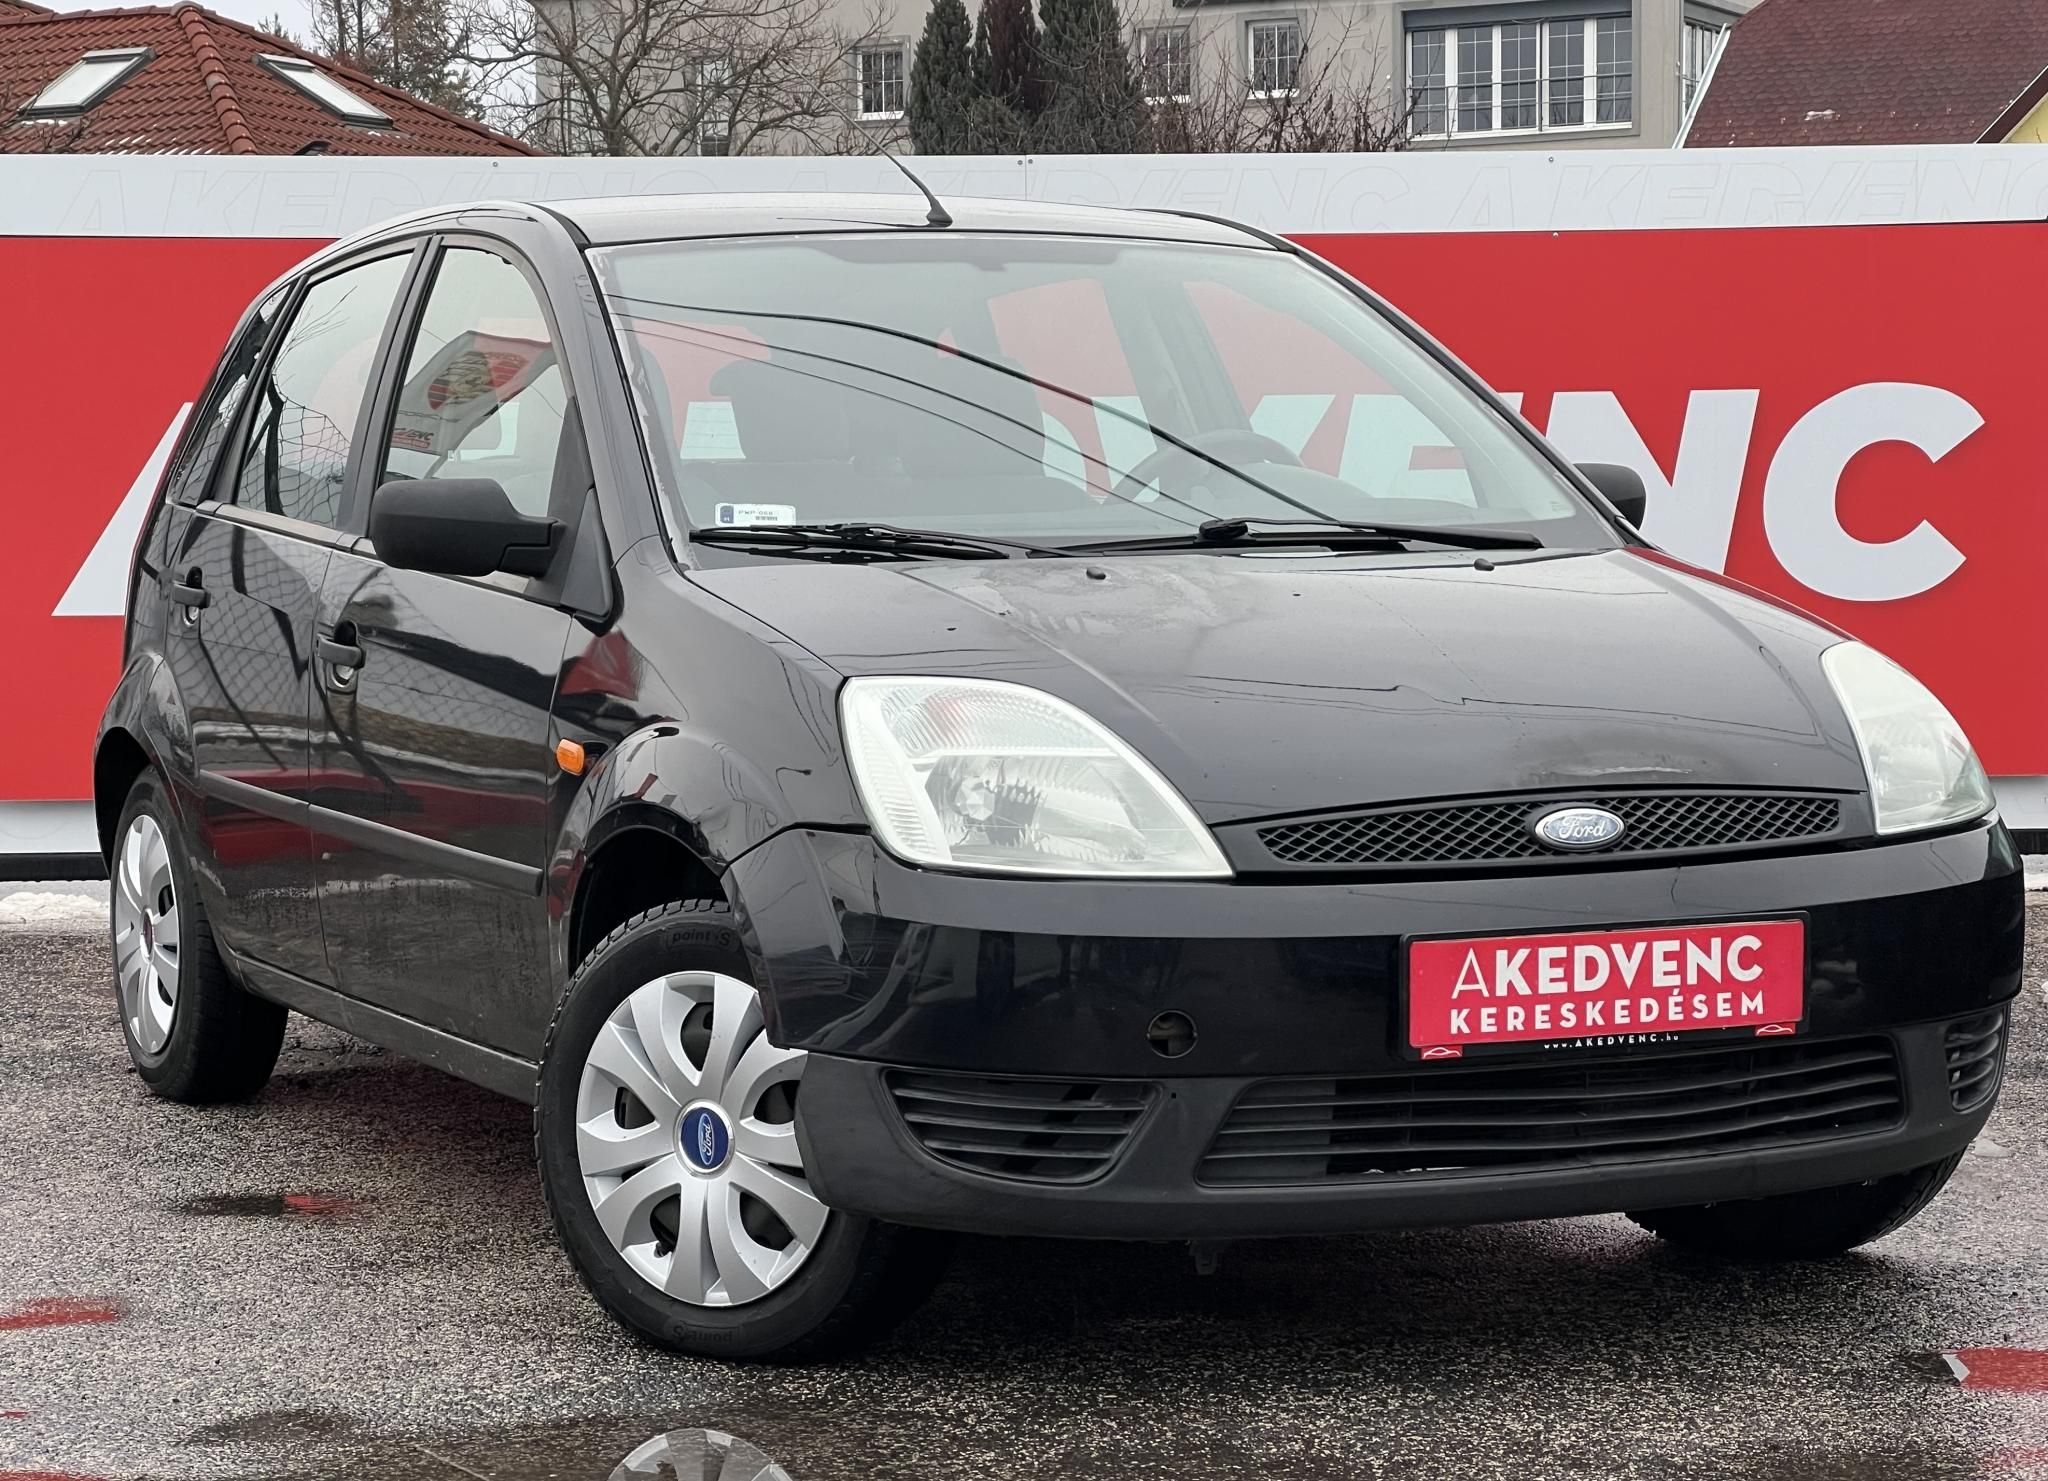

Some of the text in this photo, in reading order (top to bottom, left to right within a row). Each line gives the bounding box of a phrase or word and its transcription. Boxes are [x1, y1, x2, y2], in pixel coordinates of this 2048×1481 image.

[1558, 815, 1607, 839] Ford
[1450, 988, 1765, 1035] KERESKEDÉSEM
[1544, 1032, 1679, 1049] www.AKEDVENC.hu
